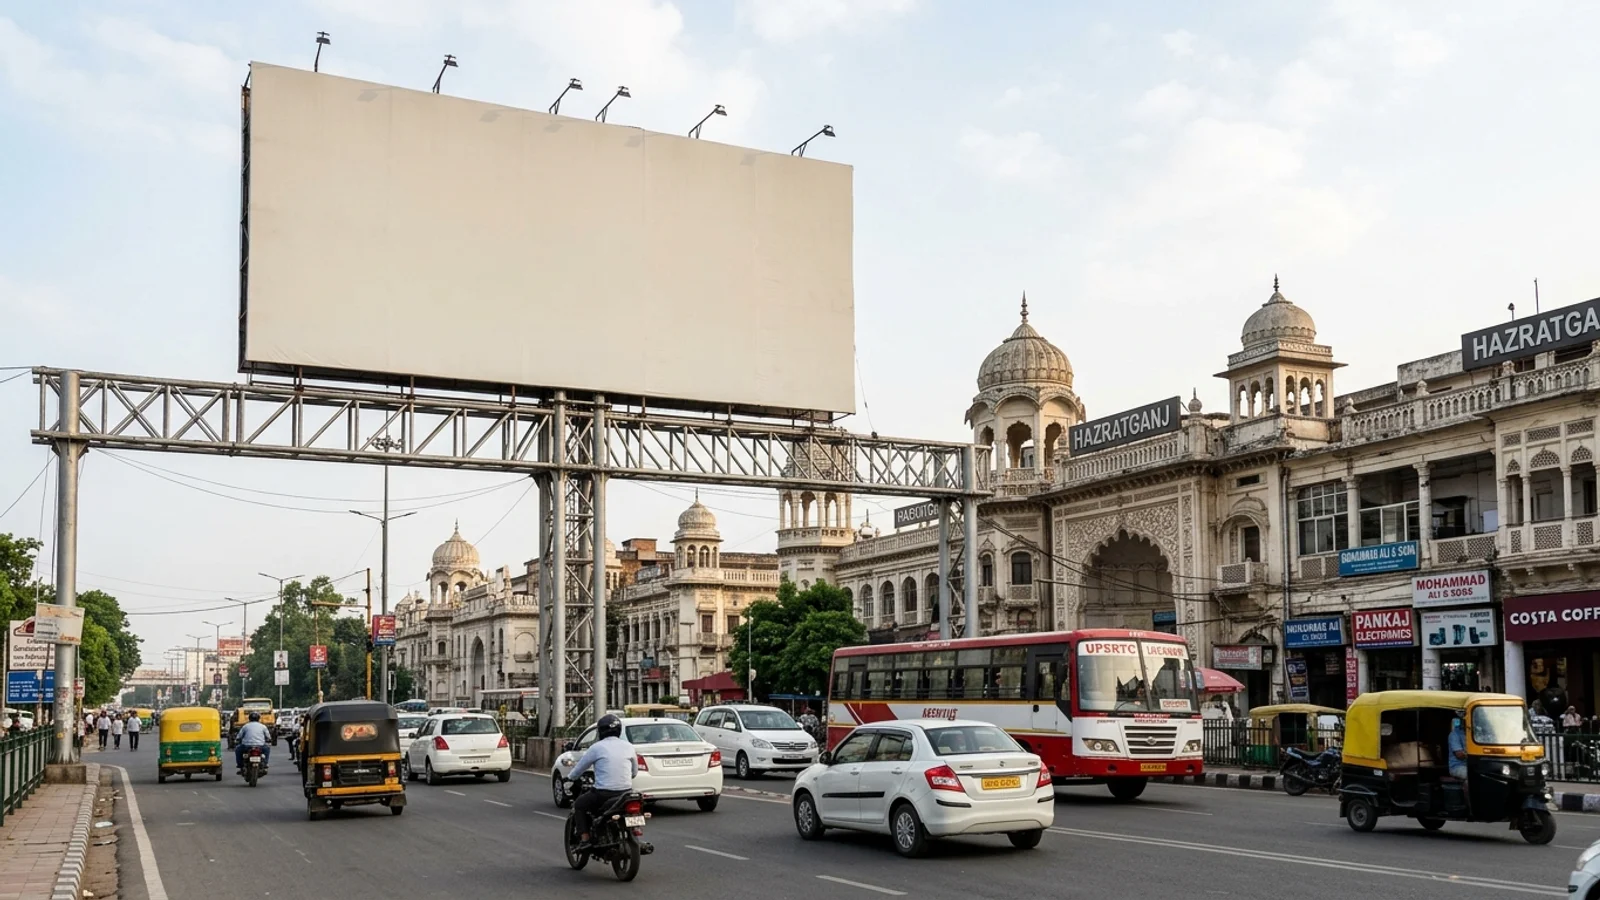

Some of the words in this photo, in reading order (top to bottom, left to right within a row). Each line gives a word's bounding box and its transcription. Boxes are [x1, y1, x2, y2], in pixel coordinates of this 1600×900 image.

[1074, 404, 1170, 450] HAZRATGANJ
[1416, 574, 1486, 590] MOHAMMAD
[1355, 611, 1410, 630] PANKAJ
[1510, 610, 1557, 625] COSTA
[1561, 606, 1600, 622] COFF
[1085, 643, 1136, 654] UPSRTC
